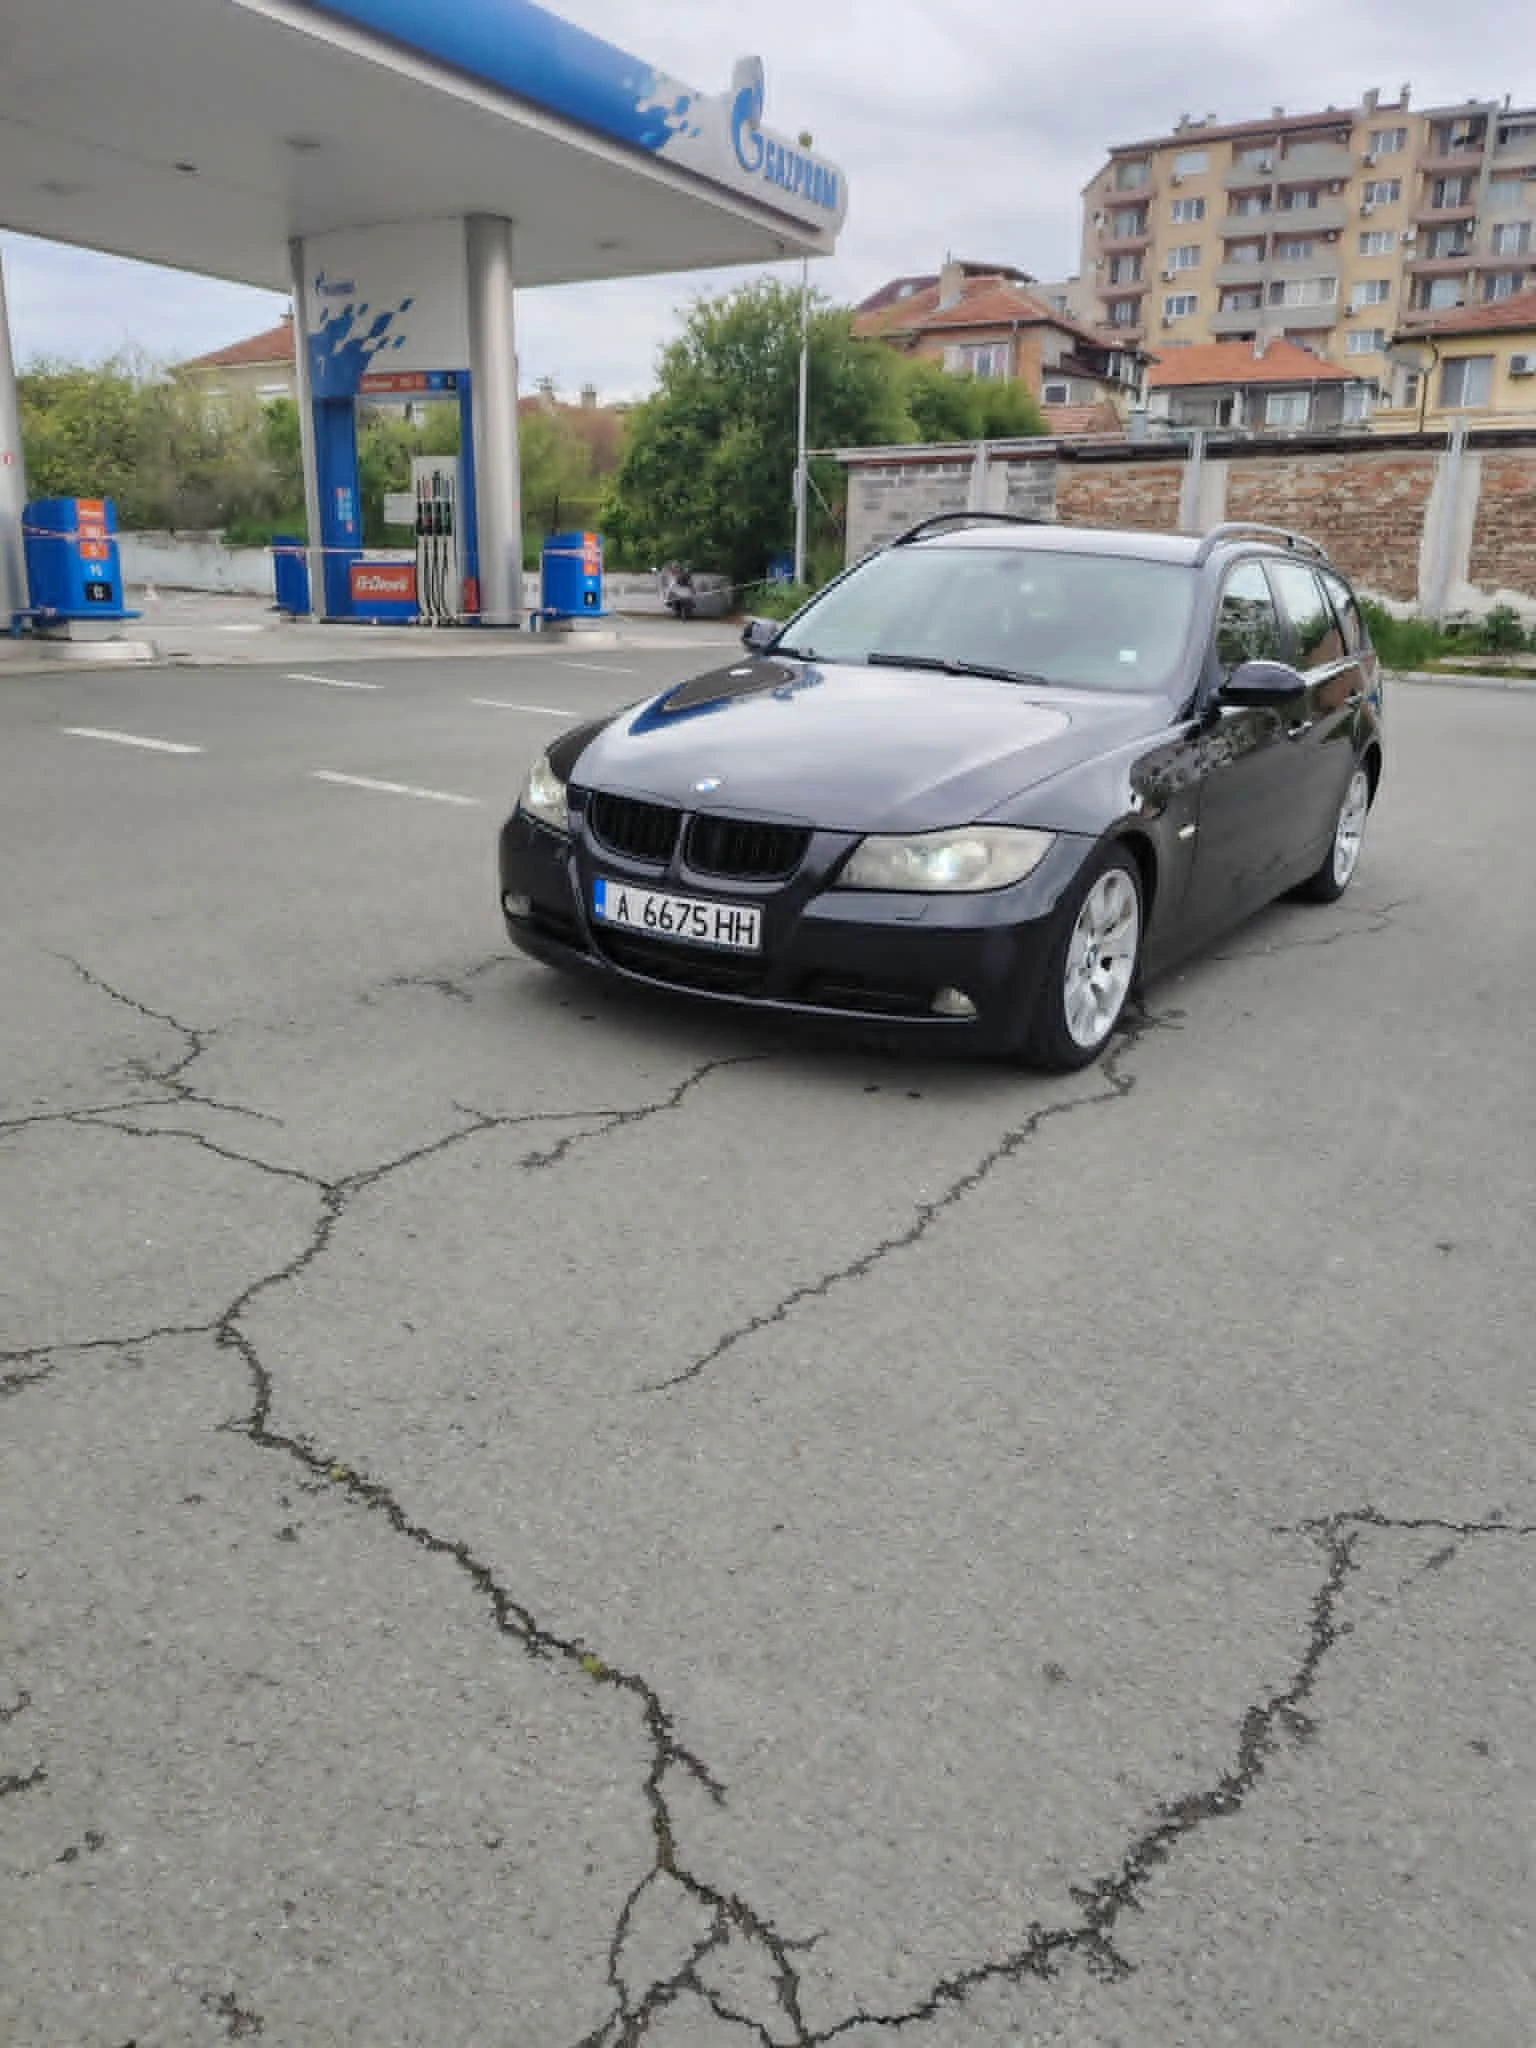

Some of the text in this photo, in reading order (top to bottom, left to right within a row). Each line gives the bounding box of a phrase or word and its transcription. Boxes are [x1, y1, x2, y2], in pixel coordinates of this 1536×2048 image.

[617, 889, 755, 945] A 6675 HH
